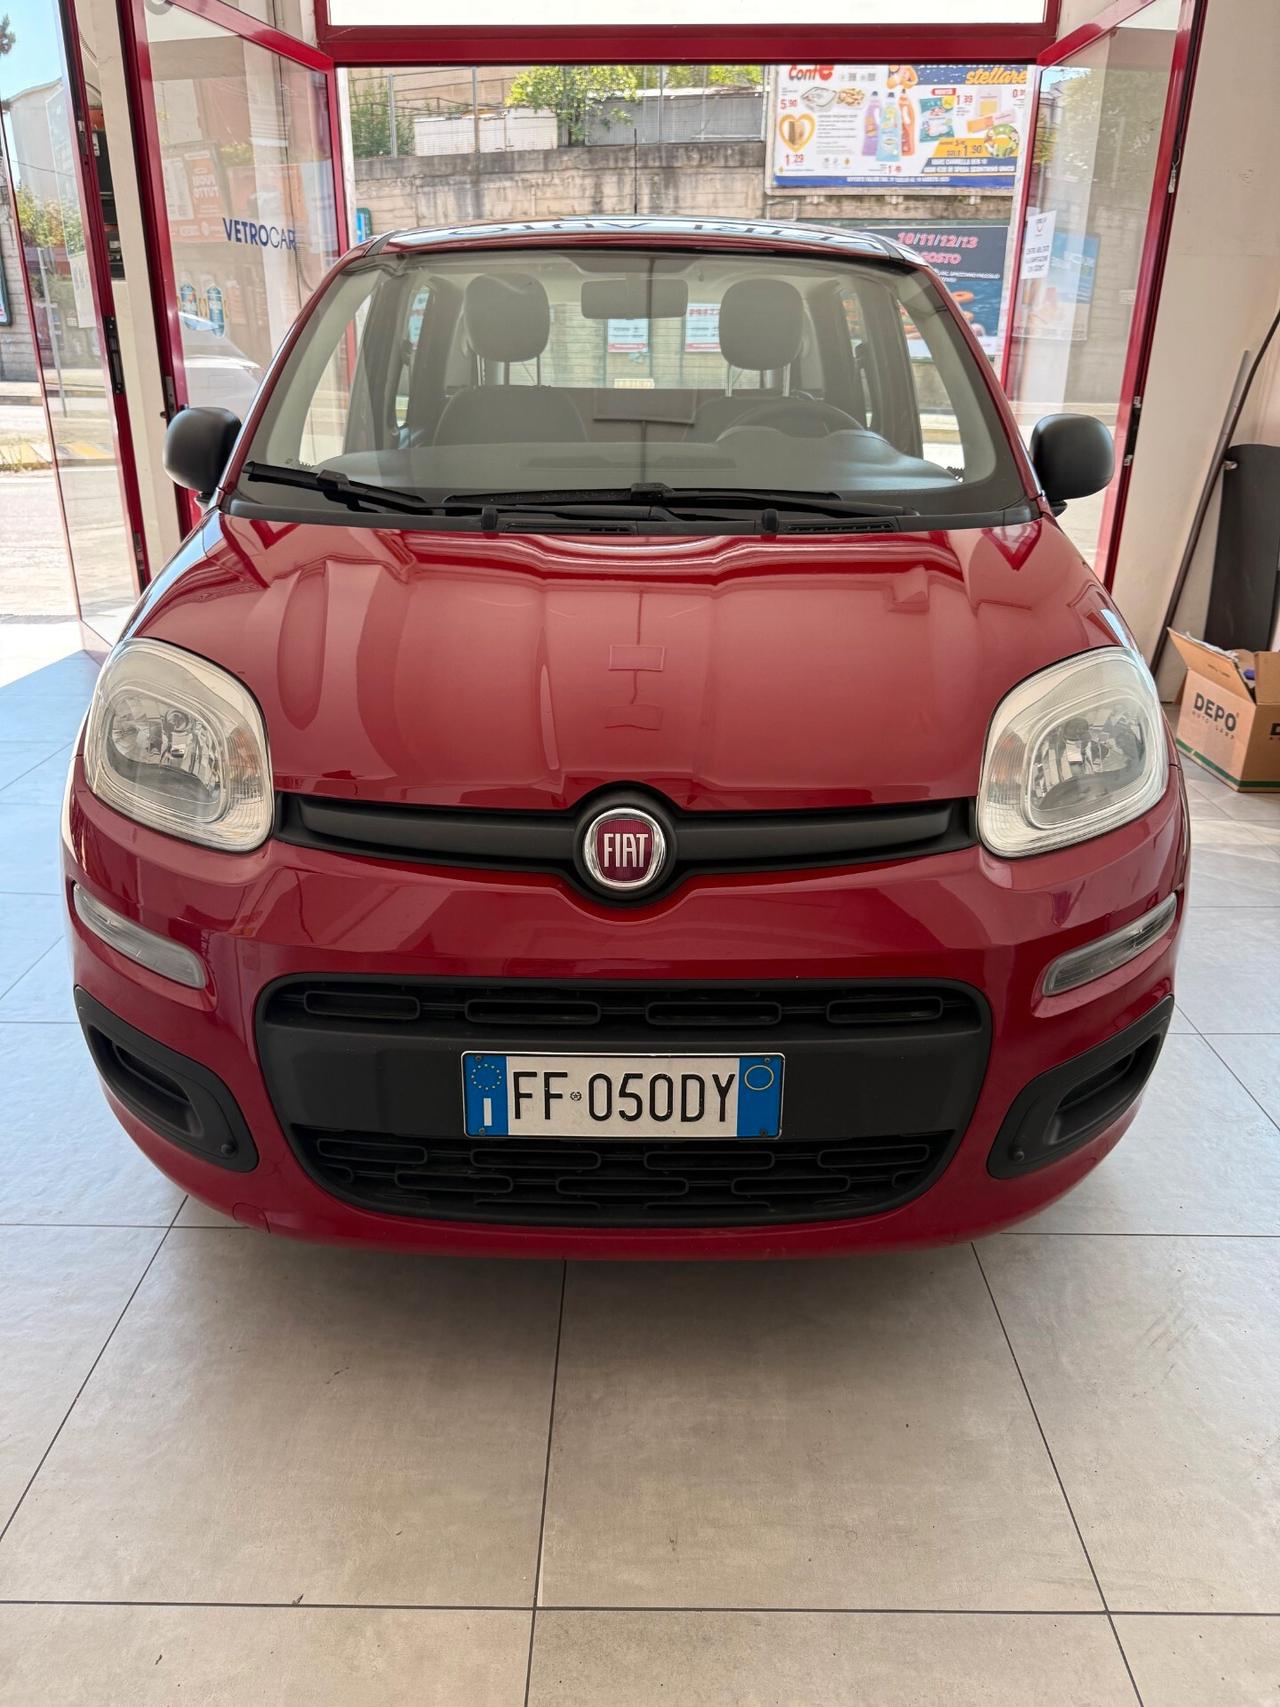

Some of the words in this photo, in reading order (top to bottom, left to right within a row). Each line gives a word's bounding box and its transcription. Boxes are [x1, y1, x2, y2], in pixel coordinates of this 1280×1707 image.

[222, 217, 297, 250] VETROCAR
[897, 232, 979, 248] 10/11/12/13
[919, 251, 962, 264] GOSTO
[1194, 692, 1237, 732] DEPO
[603, 833, 649, 868] FIAT
[513, 1071, 568, 1120] FF
[588, 1072, 736, 1122] 050DY
